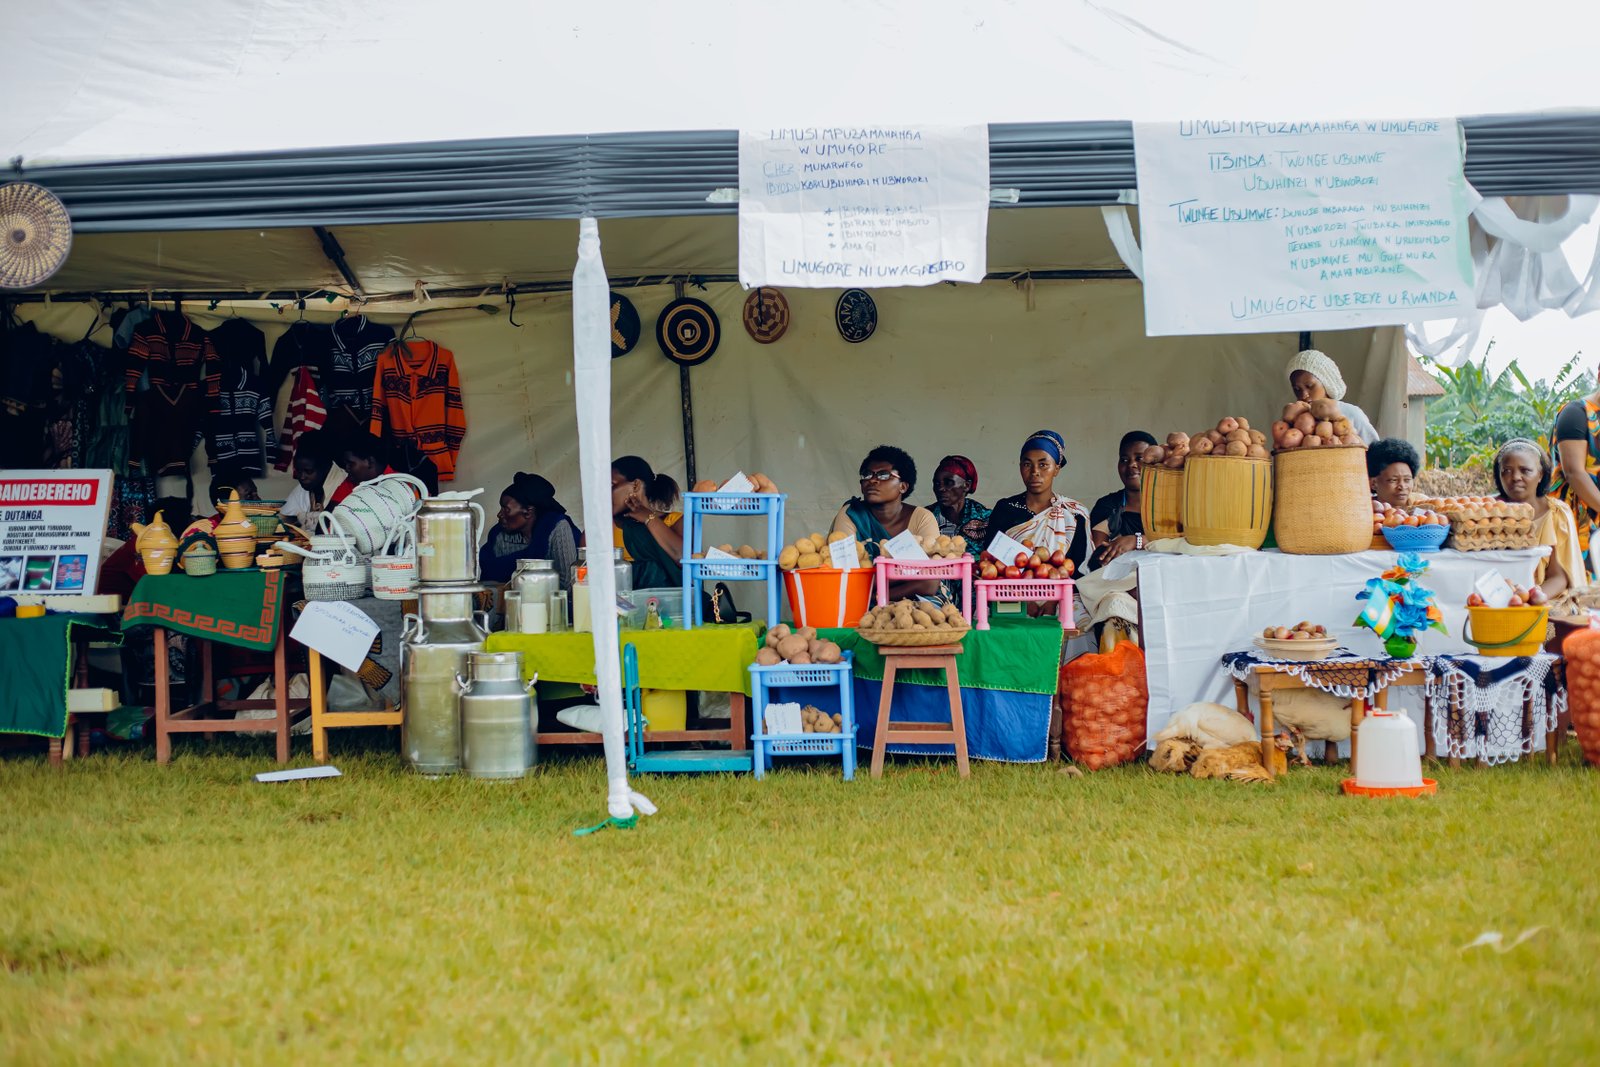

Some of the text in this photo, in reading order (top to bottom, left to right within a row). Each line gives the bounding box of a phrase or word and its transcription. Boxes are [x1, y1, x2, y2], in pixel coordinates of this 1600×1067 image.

[1333, 151, 1386, 165] UBUMWE
[1230, 294, 1317, 319] UMUGORE
[0, 483, 91, 501] ANDEBEREHO
[5, 510, 43, 520] DUTANGA
